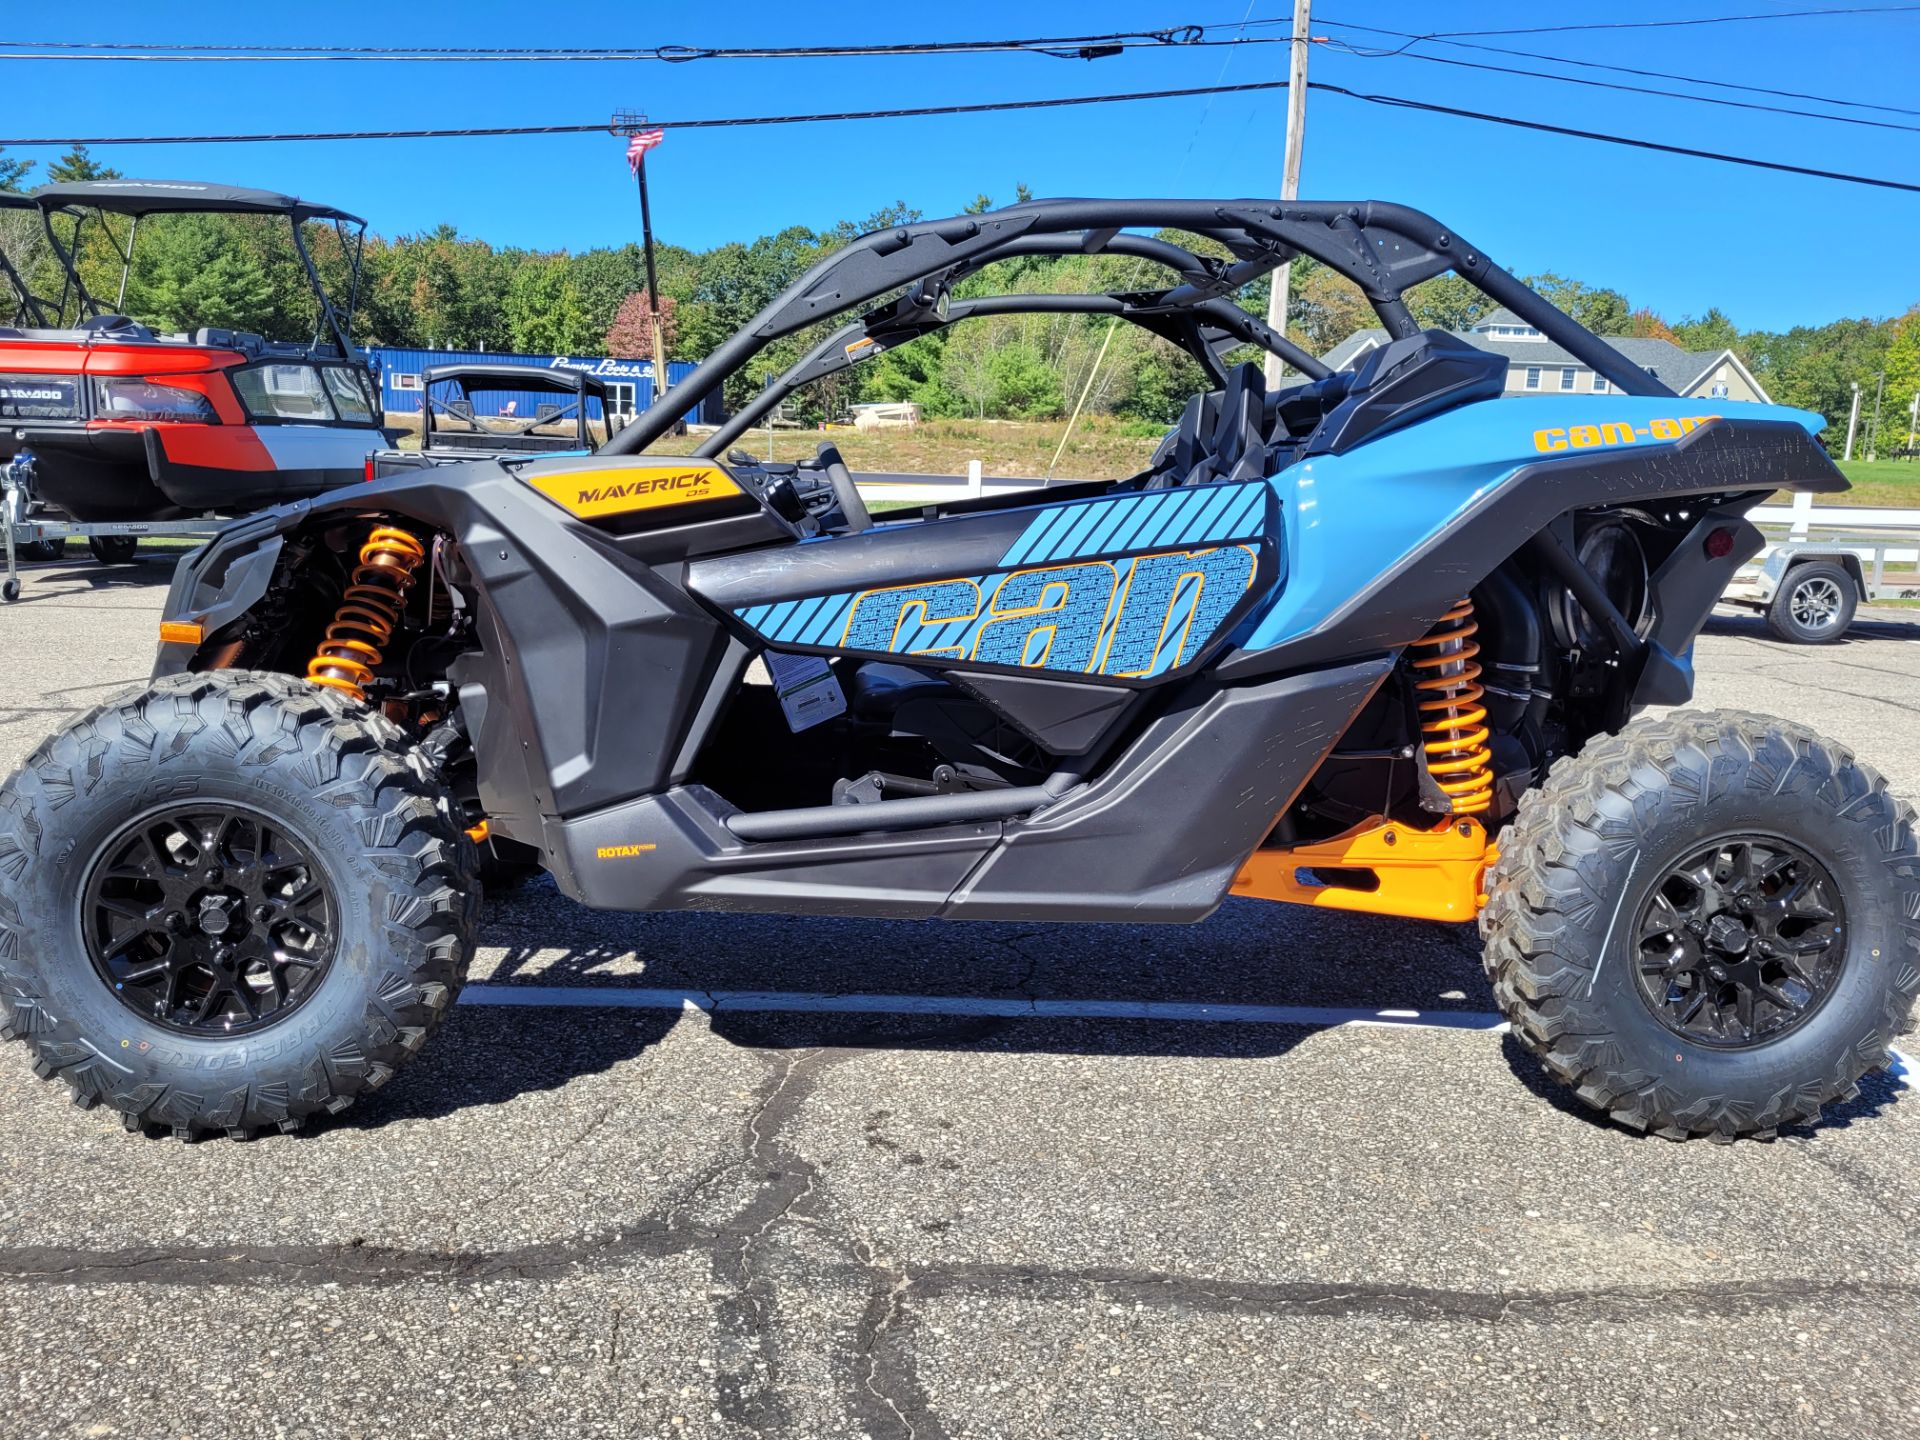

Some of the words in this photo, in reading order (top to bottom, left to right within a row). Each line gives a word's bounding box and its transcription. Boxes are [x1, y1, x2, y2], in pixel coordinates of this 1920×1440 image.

[549, 356, 595, 370] Premier
[594, 359, 629, 375] Pools
[631, 365, 640, 373] &
[578, 471, 712, 504] MAVERICK
[686, 488, 709, 497] DS
[840, 545, 1258, 679] can
[597, 845, 640, 858] ROTAX
